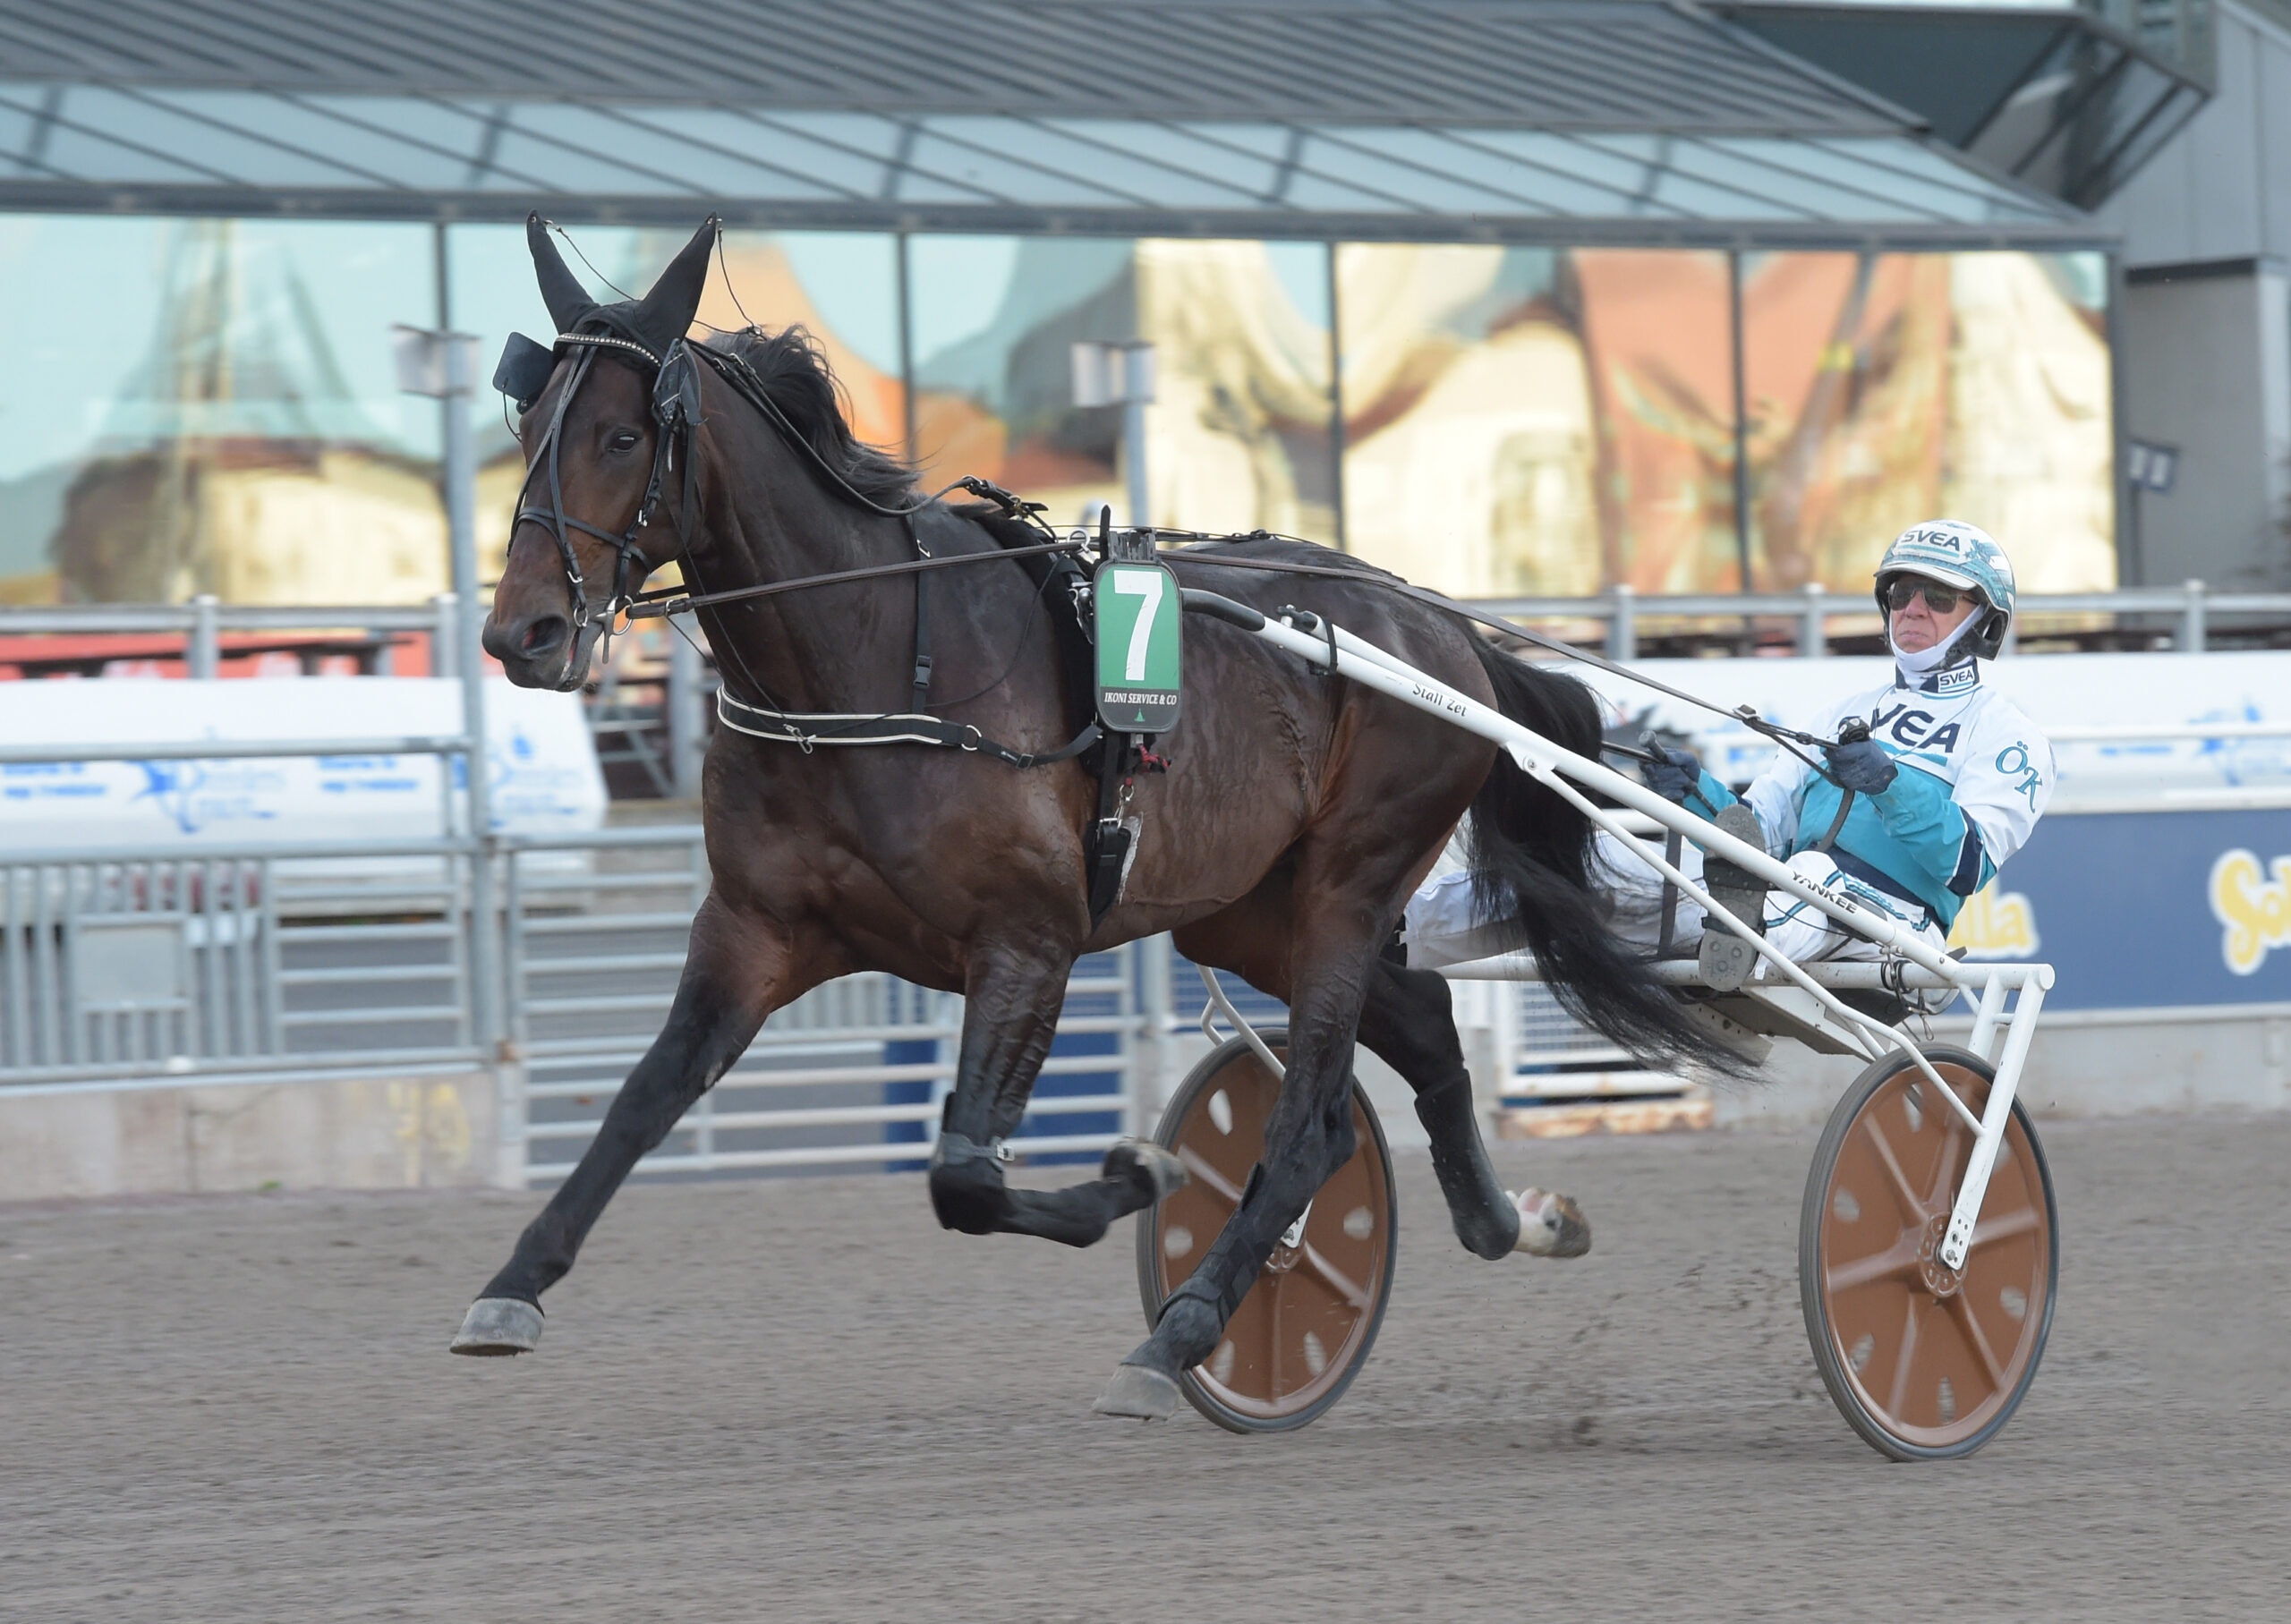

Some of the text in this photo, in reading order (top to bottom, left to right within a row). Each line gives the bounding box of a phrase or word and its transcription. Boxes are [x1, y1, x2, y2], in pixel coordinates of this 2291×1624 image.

[1901, 530, 1960, 551] SVEA
[1113, 570, 1163, 680] 7
[1939, 669, 1973, 685] SVEA
[1104, 692, 1177, 705] IKONI SERVICE & CO
[1412, 683, 1443, 706] Stall
[1845, 703, 1961, 753] VEA
[1793, 870, 1858, 914] YANKEE
